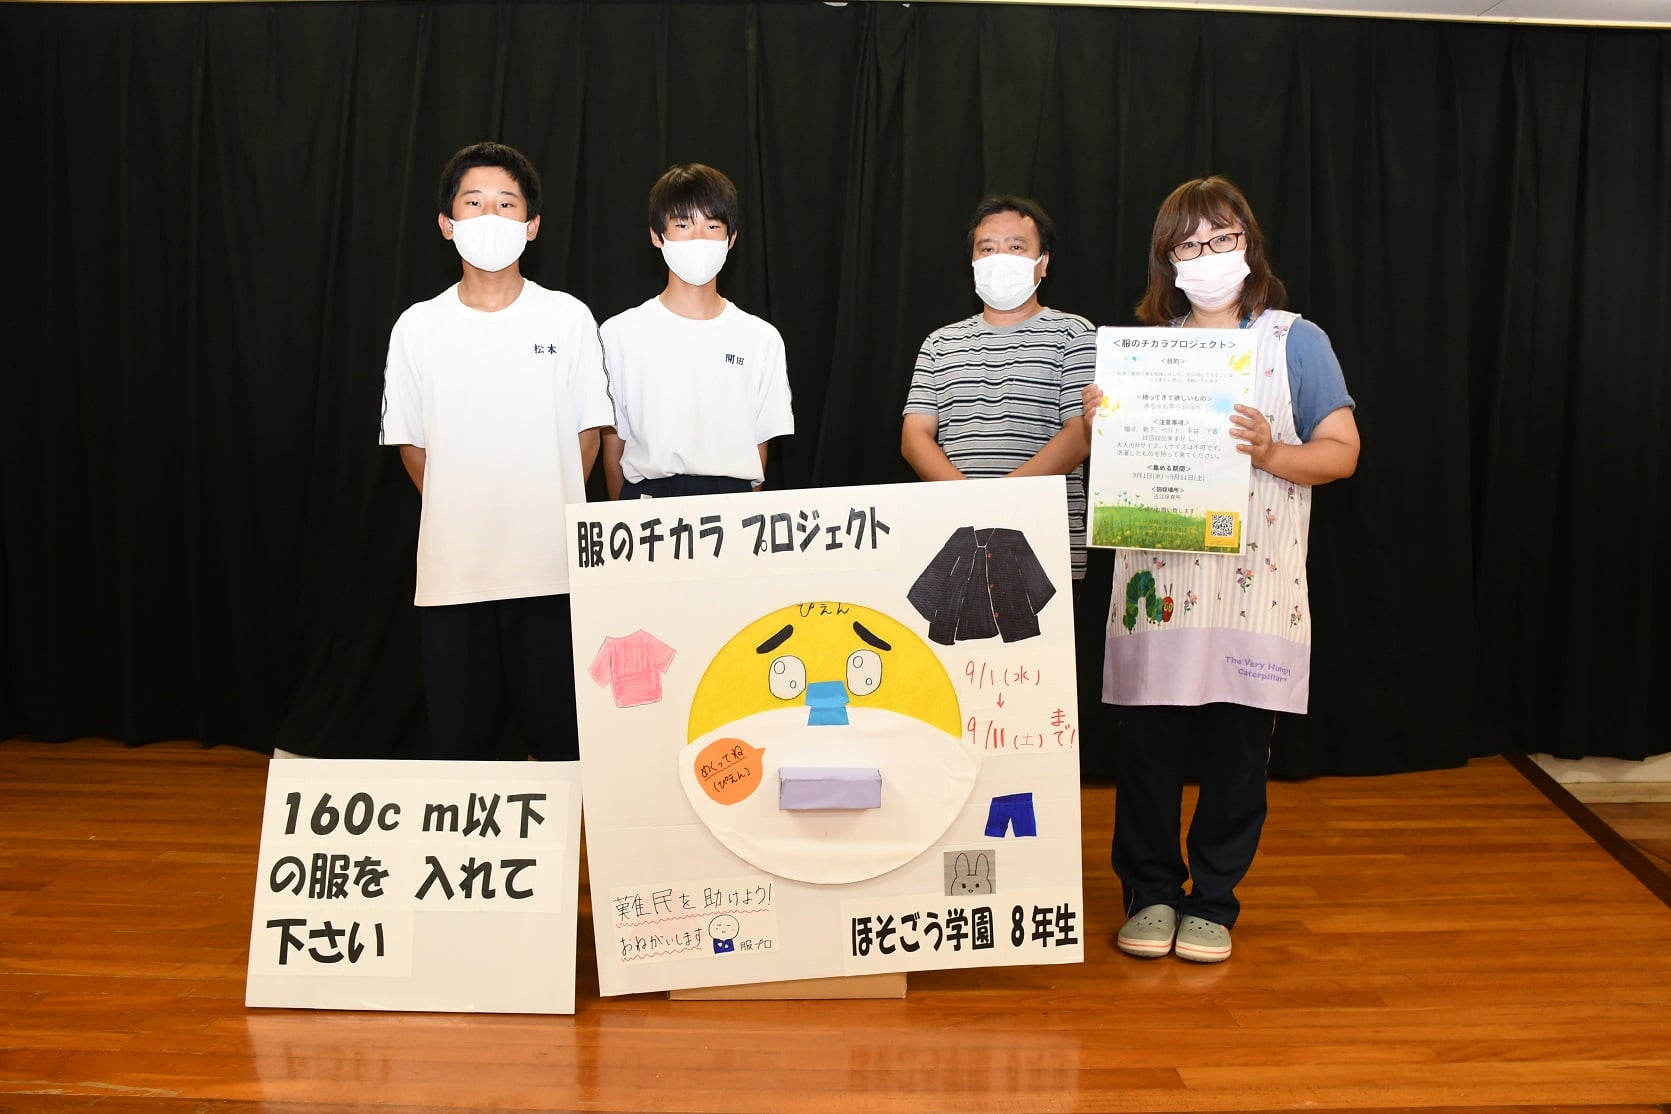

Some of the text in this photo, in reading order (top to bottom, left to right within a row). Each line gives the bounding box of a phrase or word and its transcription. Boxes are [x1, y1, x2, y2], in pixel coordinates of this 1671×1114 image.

[534, 343, 557, 355] 松本
[577, 505, 891, 569] 服のチカラ プロジェクト
[798, 601, 851, 618] ぴえん
[1225, 656, 1242, 665] The
[1245, 659, 1265, 670] Very
[700, 745, 744, 778] めくってね
[269, 853, 537, 900] の服を 入れて
[266, 918, 385, 966] 下さい
[620, 928, 703, 957] おねがいします
[740, 939, 772, 951] 服プロ
[851, 903, 1079, 958] ほそごう学園 8年生
